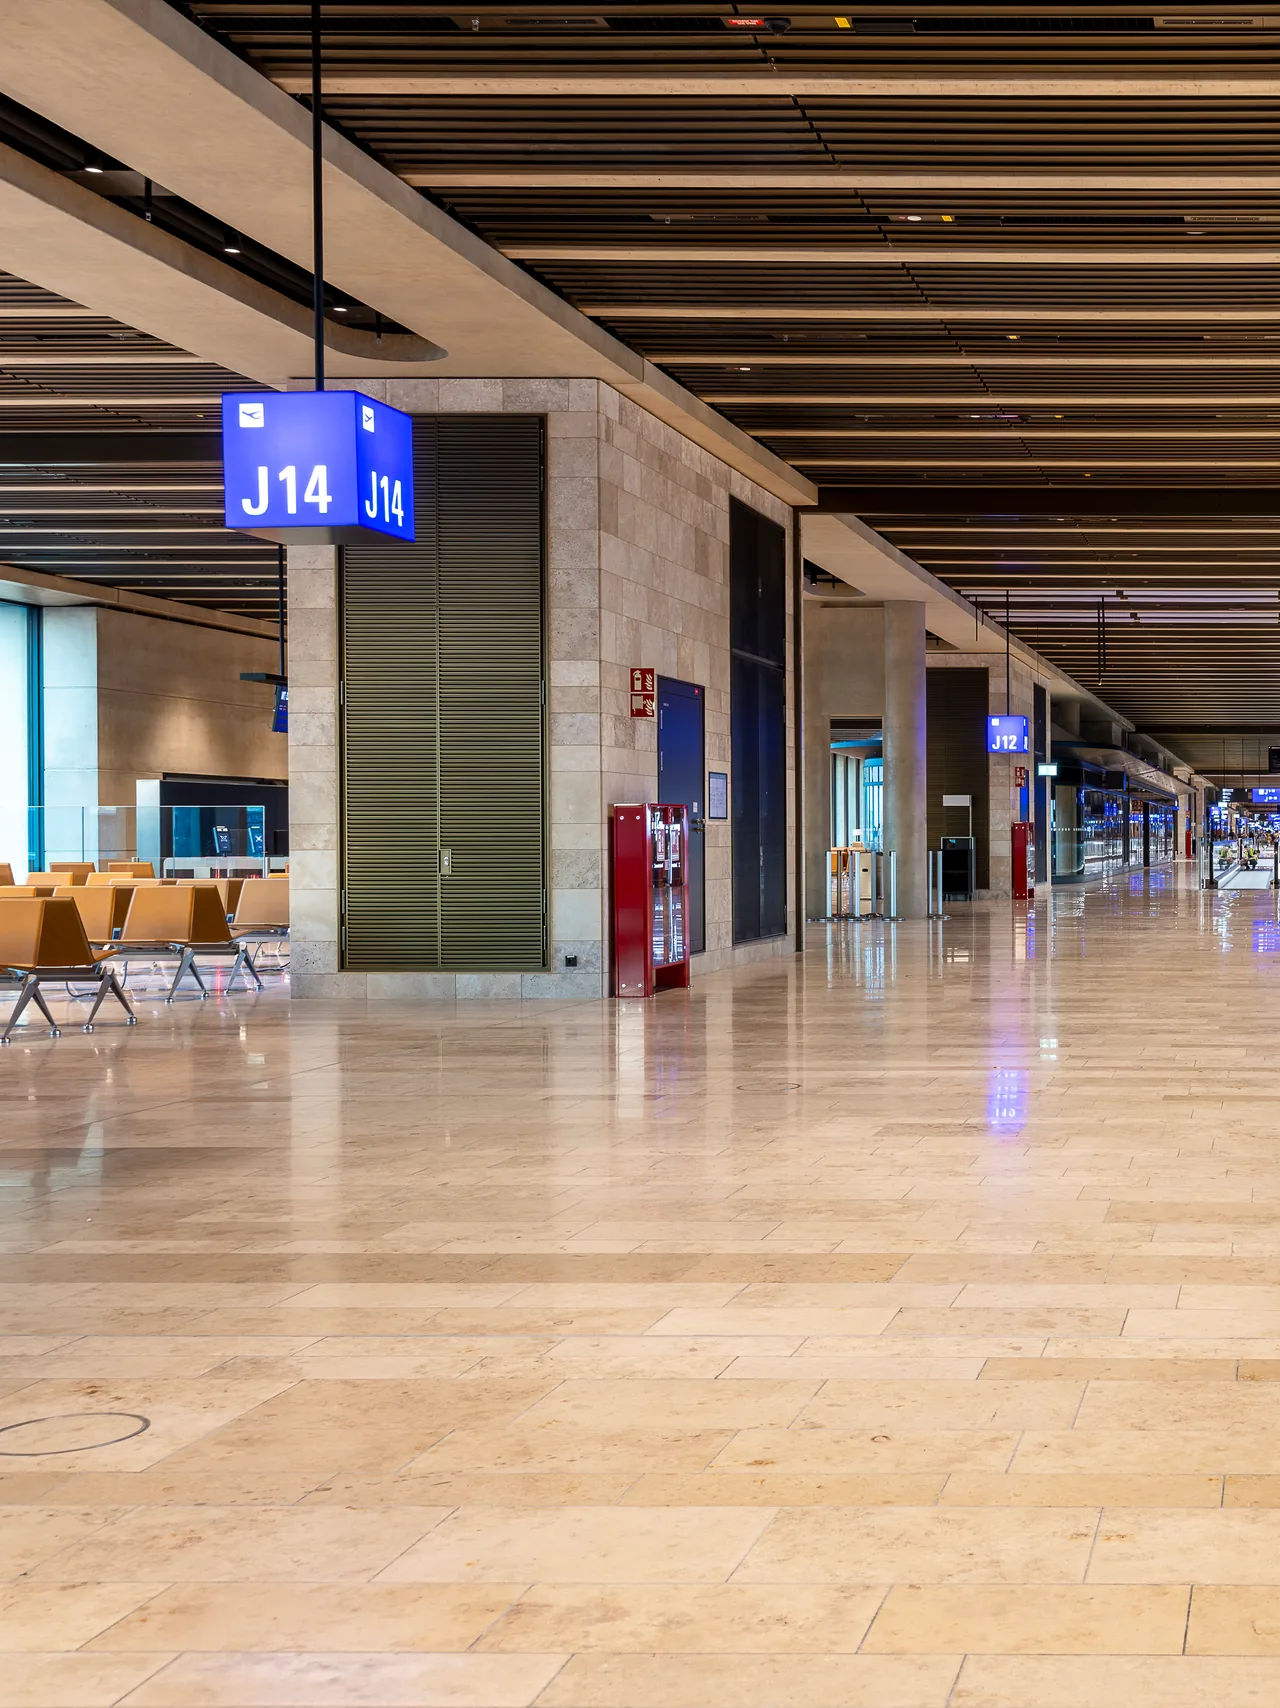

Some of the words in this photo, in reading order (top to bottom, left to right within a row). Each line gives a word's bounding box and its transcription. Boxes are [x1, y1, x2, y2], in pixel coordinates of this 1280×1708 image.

[241, 464, 333, 516] J14
[365, 470, 404, 527] J14
[991, 734, 1018, 750] J12
